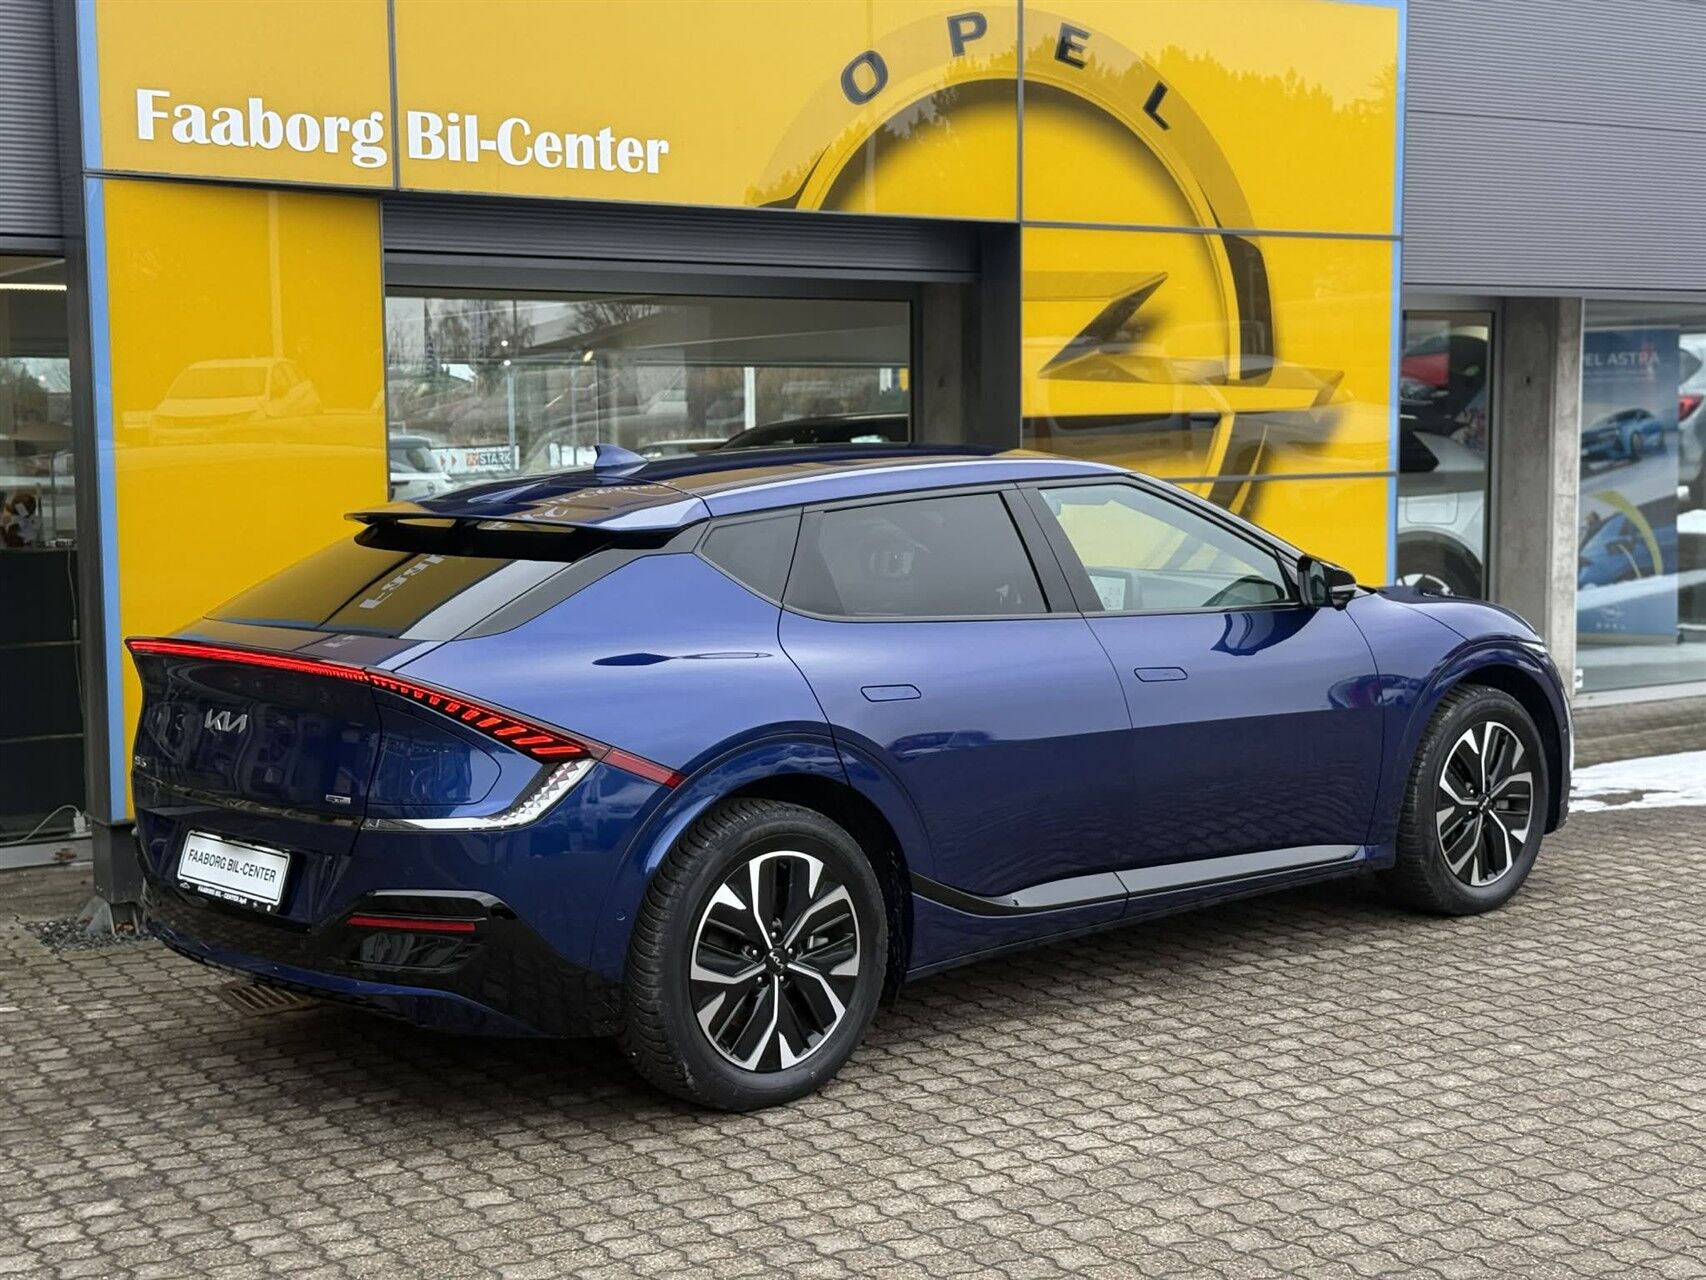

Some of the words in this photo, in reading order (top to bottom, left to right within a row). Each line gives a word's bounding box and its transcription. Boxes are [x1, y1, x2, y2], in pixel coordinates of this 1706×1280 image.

[840, 11, 1172, 131] OPEL
[136, 88, 388, 169] Faaborg
[407, 110, 670, 174] Bil-Center
[1582, 352, 1603, 368] EL
[1607, 351, 1660, 367] ASTRA
[479, 451, 511, 465] STARK
[204, 708, 248, 733] KIA
[188, 849, 226, 870] FAABORG
[226, 858, 277, 883] BIL-CENTER
